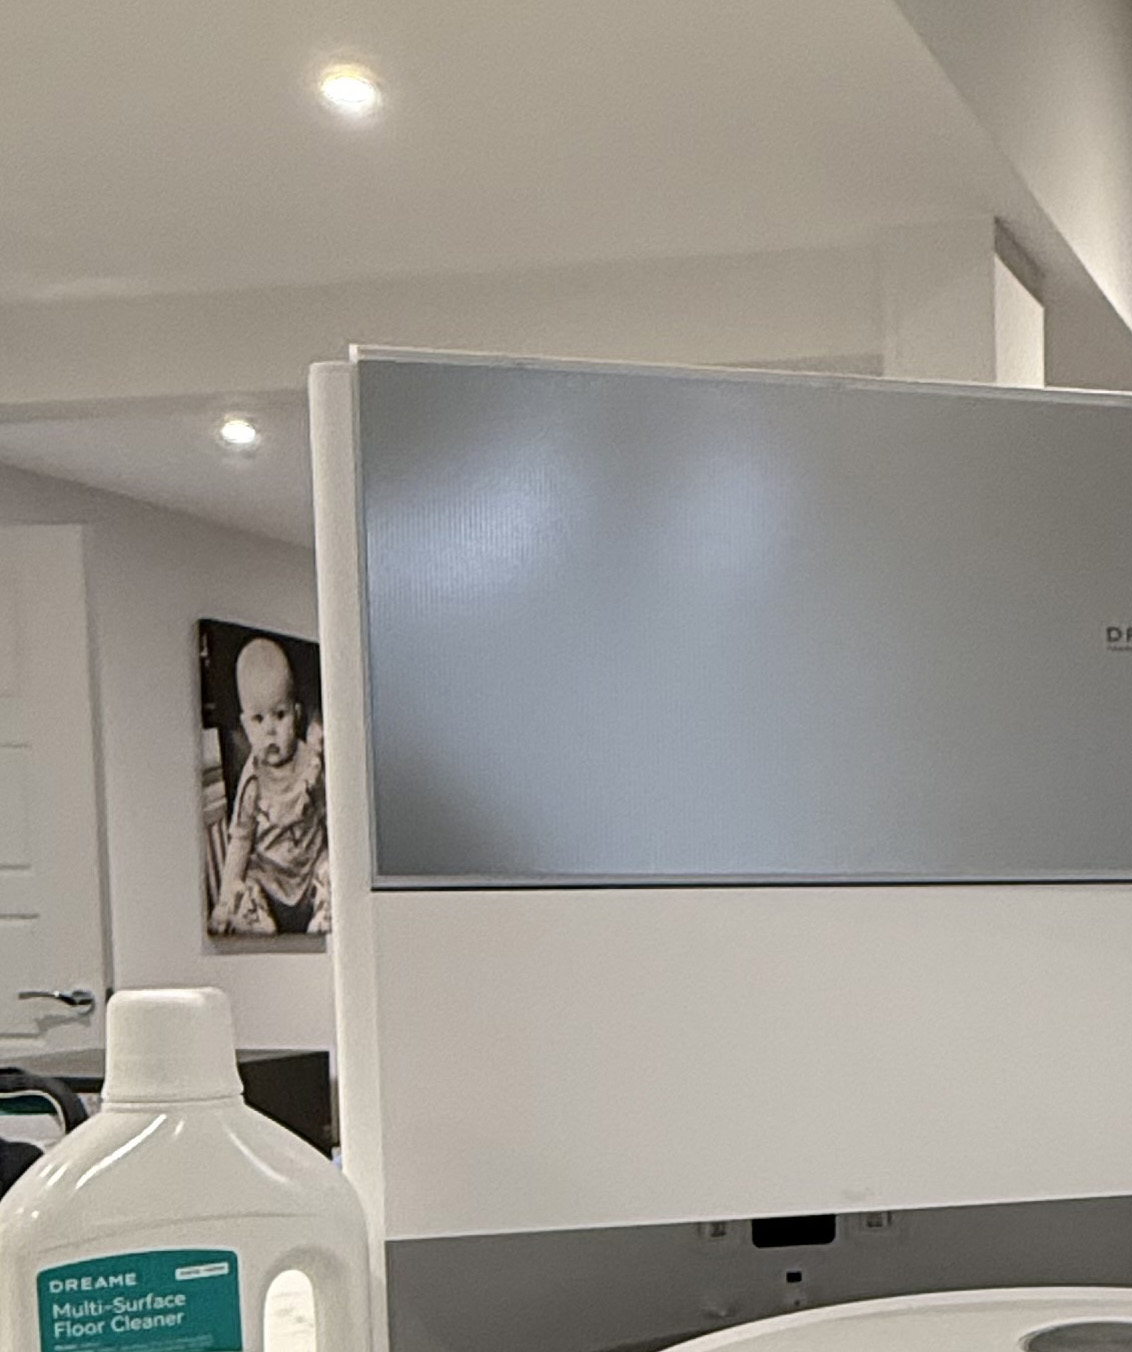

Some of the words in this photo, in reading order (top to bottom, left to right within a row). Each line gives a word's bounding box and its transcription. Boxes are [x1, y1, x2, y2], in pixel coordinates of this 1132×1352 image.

[49, 1273, 137, 1293] DREAME
[53, 1293, 186, 1319] Multi-Surface
[54, 1320, 105, 1338] Floor
[110, 1311, 184, 1332] Cleaner
